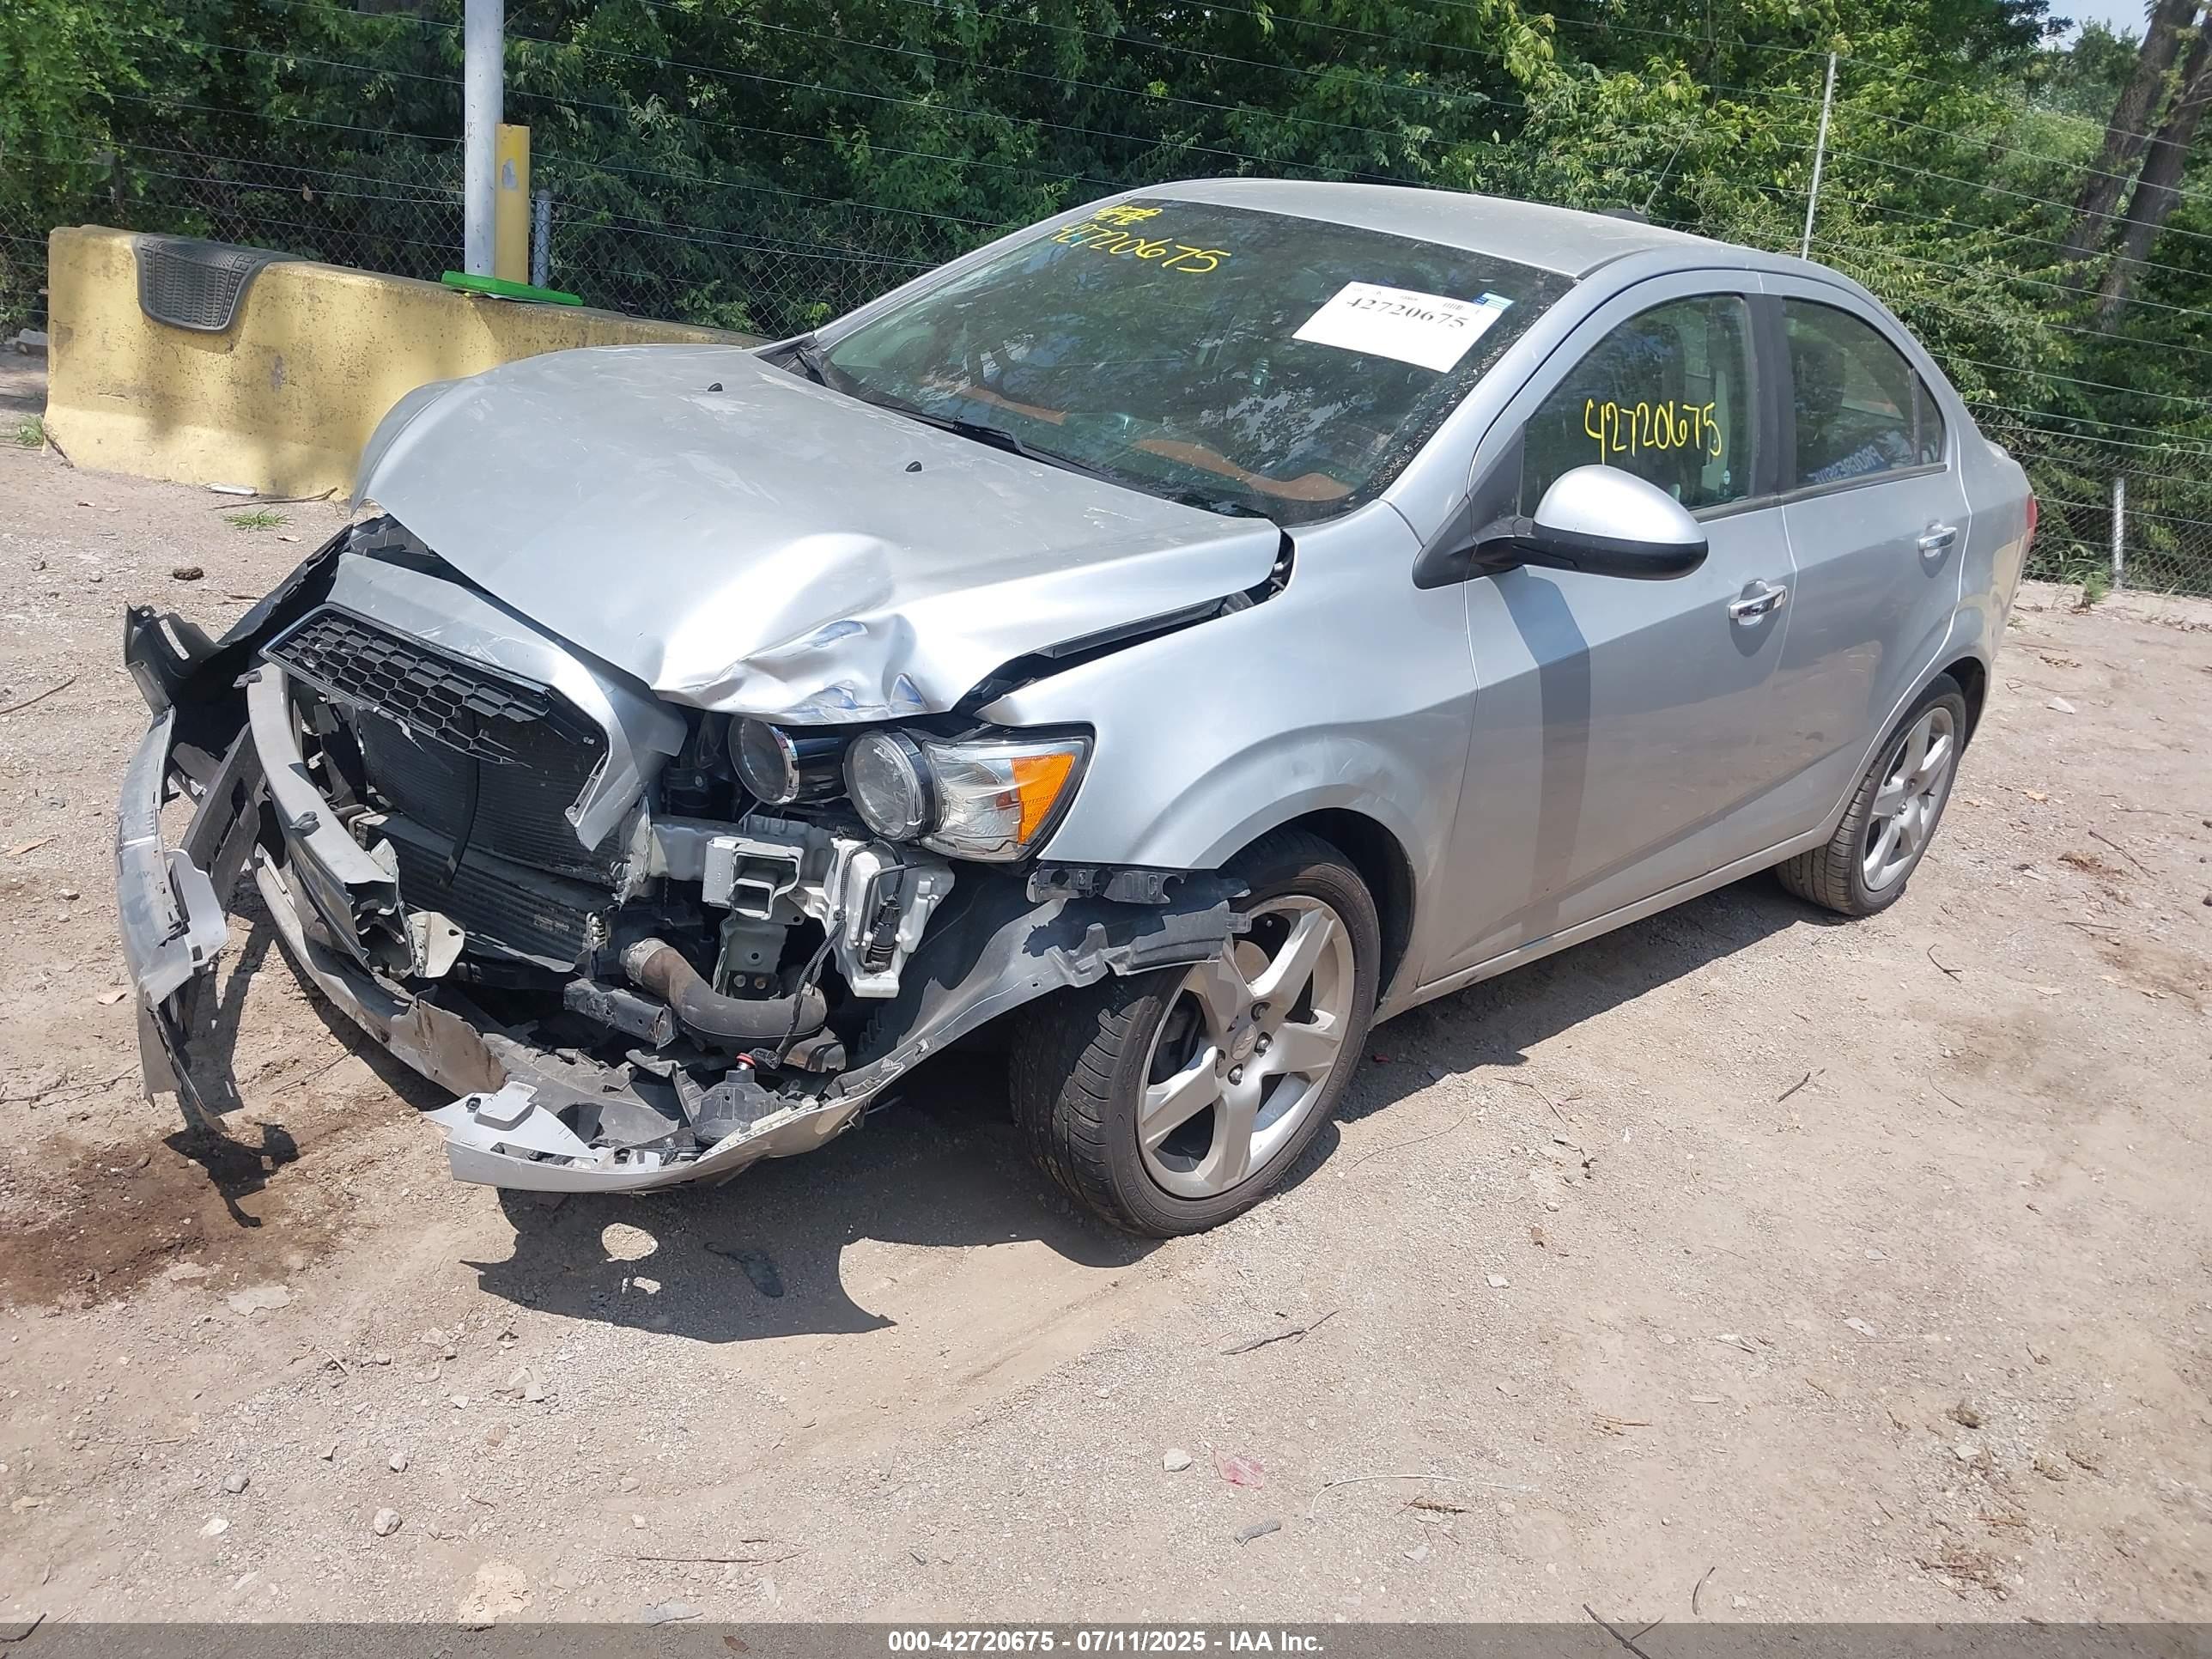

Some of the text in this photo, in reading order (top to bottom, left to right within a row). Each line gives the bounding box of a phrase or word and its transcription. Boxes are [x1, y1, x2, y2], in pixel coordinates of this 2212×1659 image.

[1051, 223, 1231, 272] 42720675
[1346, 297, 1471, 329] 42720675
[1584, 398, 1722, 465] 42720675
